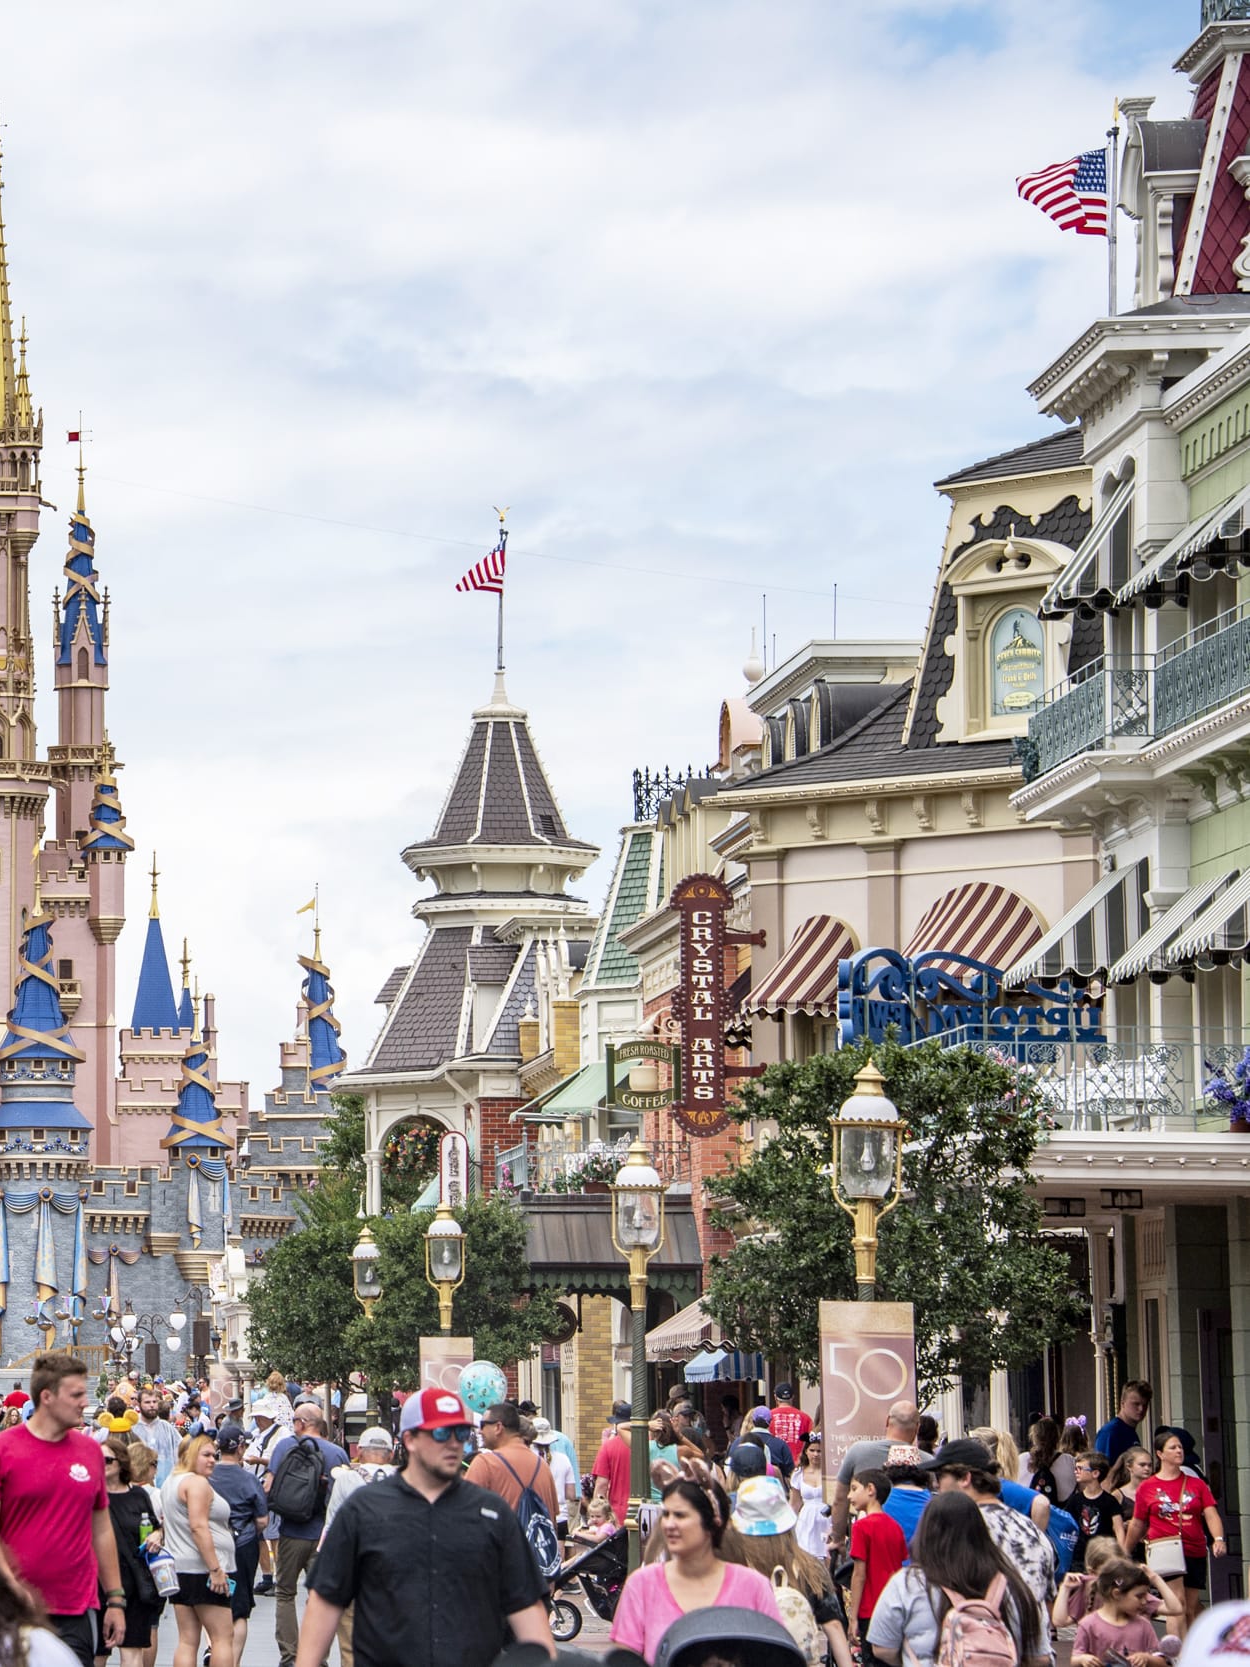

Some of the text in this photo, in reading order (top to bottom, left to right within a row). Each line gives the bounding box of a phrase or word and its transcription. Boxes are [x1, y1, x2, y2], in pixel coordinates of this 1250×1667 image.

[691, 911, 715, 1100] CRYSTAL ARTS
[620, 1044, 670, 1060] FRESH ROASTED
[622, 1093, 668, 1109] COFFEE
[829, 1343, 908, 1427] 50
